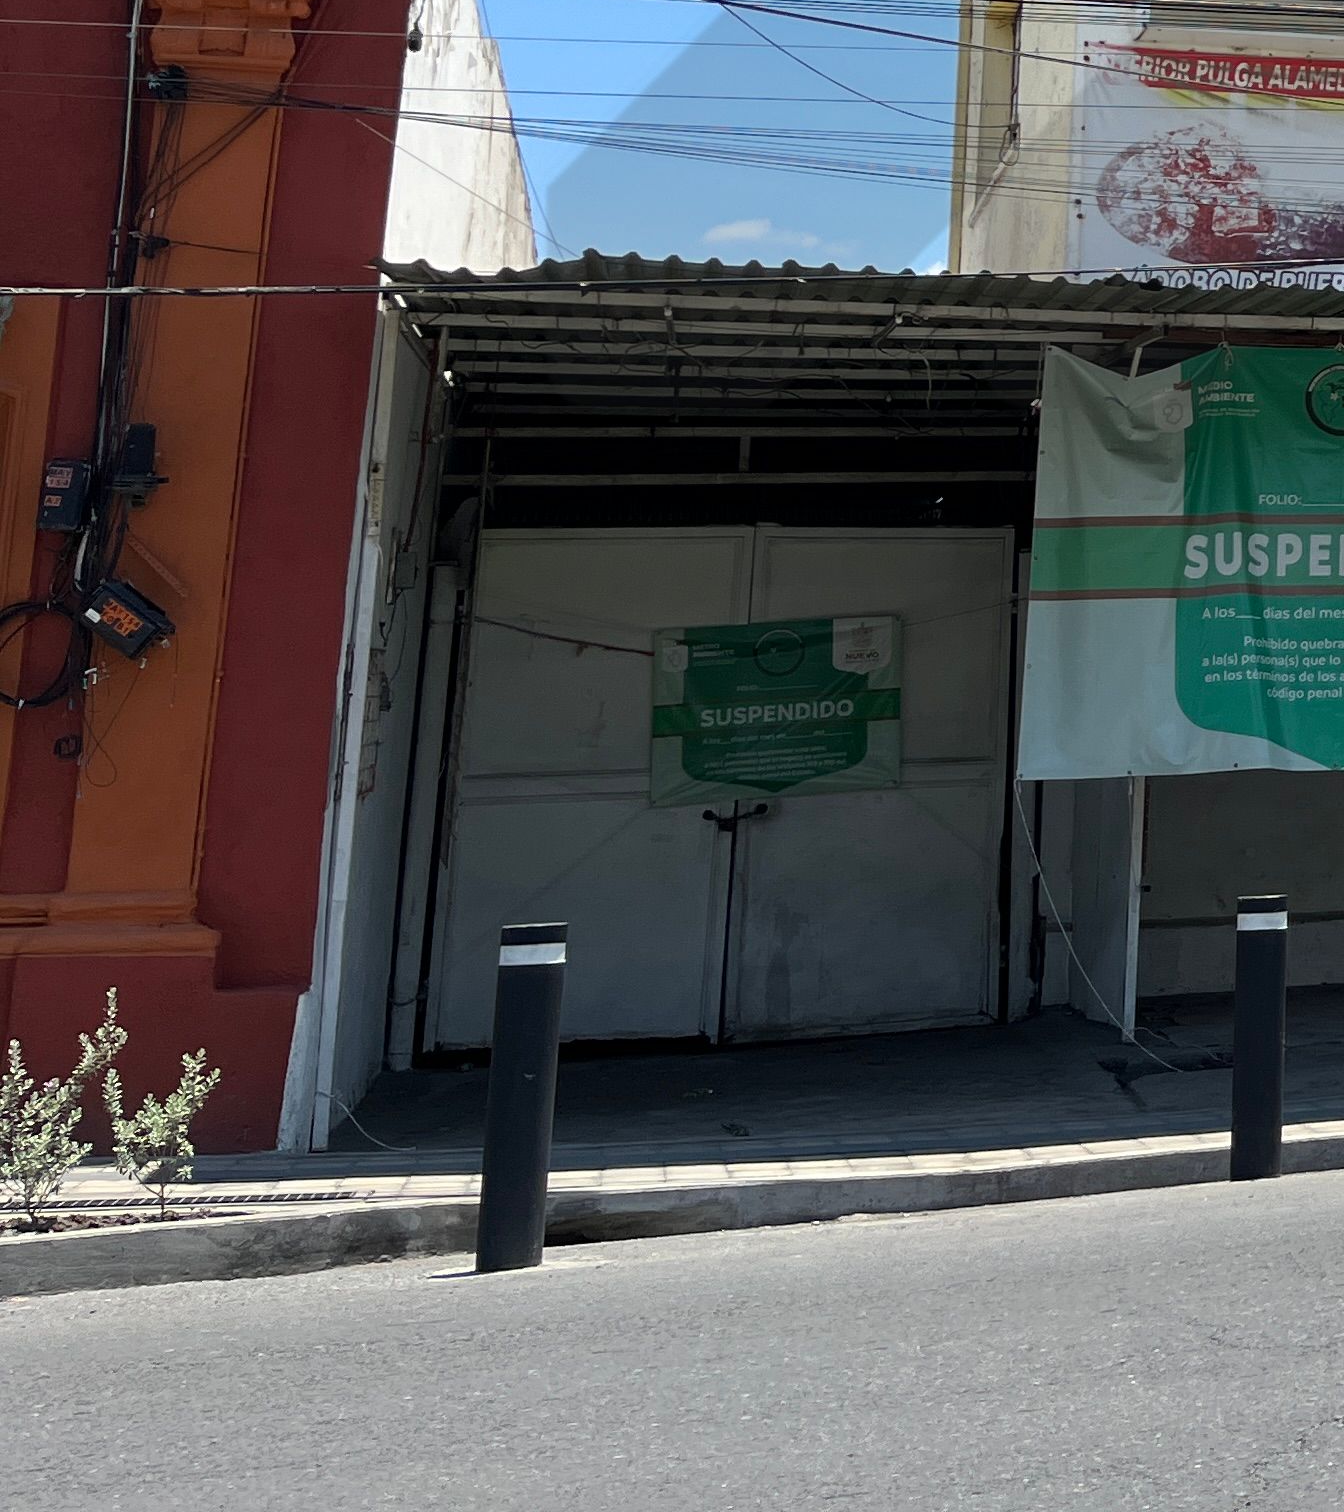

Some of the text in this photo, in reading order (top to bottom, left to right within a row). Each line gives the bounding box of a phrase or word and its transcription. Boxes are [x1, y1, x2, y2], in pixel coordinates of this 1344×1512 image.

[1196, 63, 1263, 89] PULGA
[1202, 608, 1211, 619] A
[1214, 607, 1235, 619] los
[1294, 607, 1315, 619] del
[1244, 637, 1298, 650] Prohibido
[1202, 658, 1210, 666] a
[1212, 653, 1239, 666] la(s)
[1241, 654, 1299, 668] persona(s)
[1302, 656, 1326, 668] que
[1329, 655, 1340, 665] lo
[1204, 673, 1221, 683] en
[1223, 670, 1243, 681] los
[1298, 671, 1315, 682] de
[1318, 670, 1336, 682] los
[1307, 688, 1342, 700] penal
[701, 699, 854, 728] SUSPENDIDO
